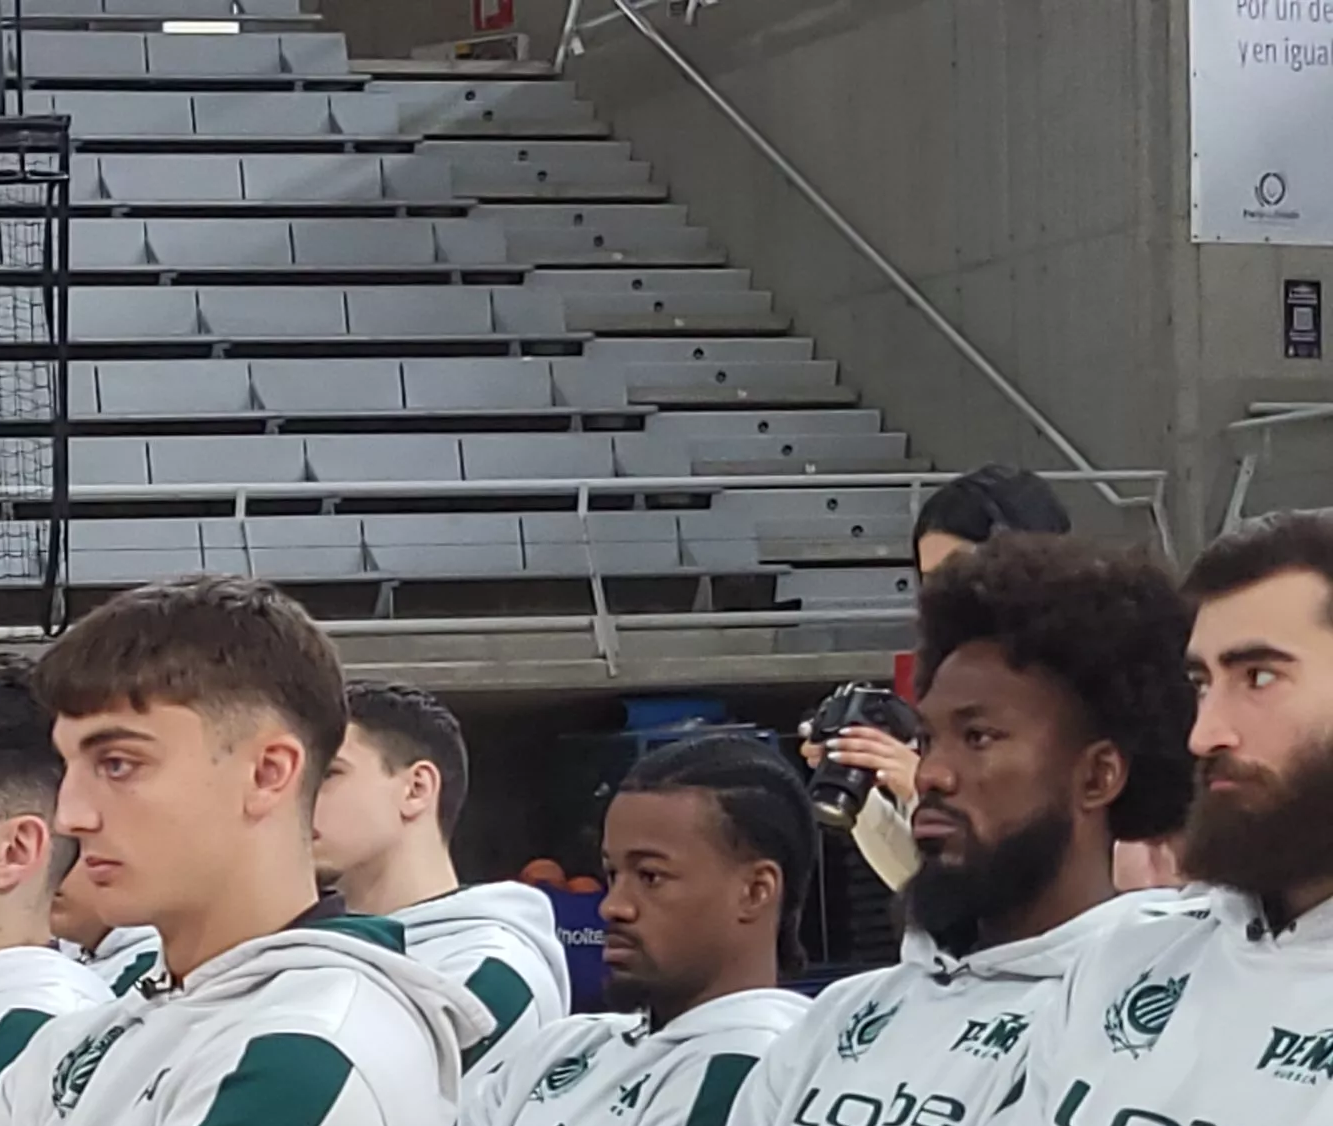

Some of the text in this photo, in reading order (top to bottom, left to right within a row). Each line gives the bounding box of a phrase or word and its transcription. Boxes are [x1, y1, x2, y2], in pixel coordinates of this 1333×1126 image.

[1276, 0, 1301, 21] un
[1237, 38, 1248, 67] y
[1253, 42, 1277, 63] en
